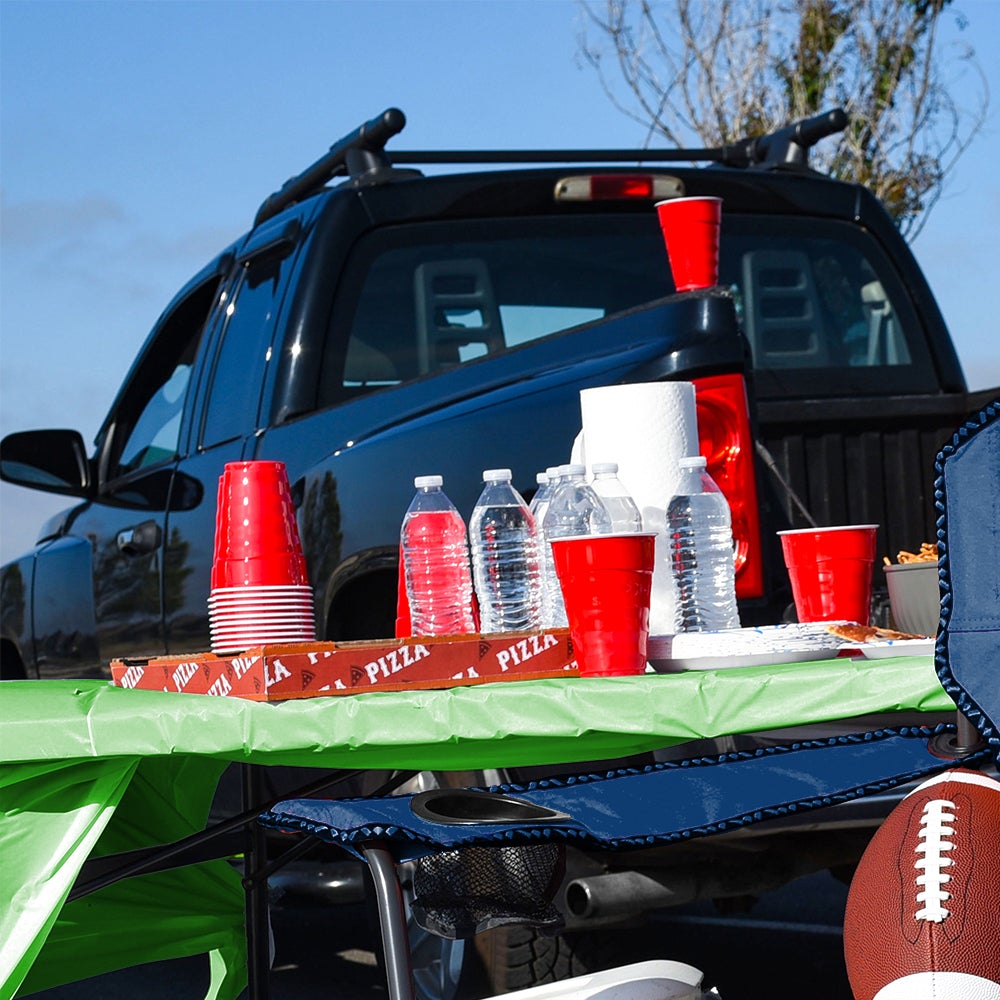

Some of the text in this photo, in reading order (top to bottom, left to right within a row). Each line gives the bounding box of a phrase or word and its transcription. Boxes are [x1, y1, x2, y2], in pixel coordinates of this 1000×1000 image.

[364, 643, 431, 685] PIZZA
[496, 634, 559, 672] PIZZA
[172, 662, 200, 693] PIZZA
